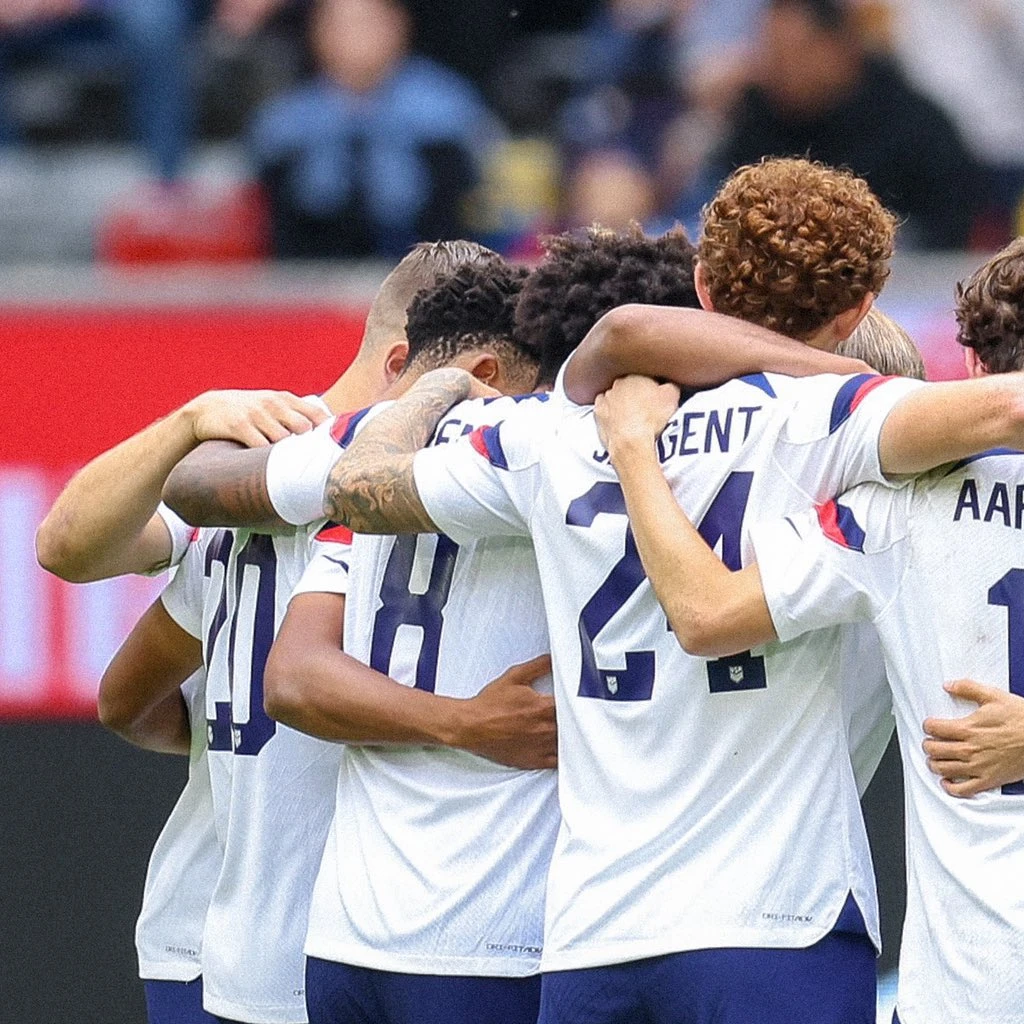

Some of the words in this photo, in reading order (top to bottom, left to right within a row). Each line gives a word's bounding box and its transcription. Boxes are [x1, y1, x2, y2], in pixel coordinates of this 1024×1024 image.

[593, 405, 762, 464] GENT
[204, 530, 277, 756] 20
[369, 532, 459, 694] 8
[565, 471, 767, 701] 24
